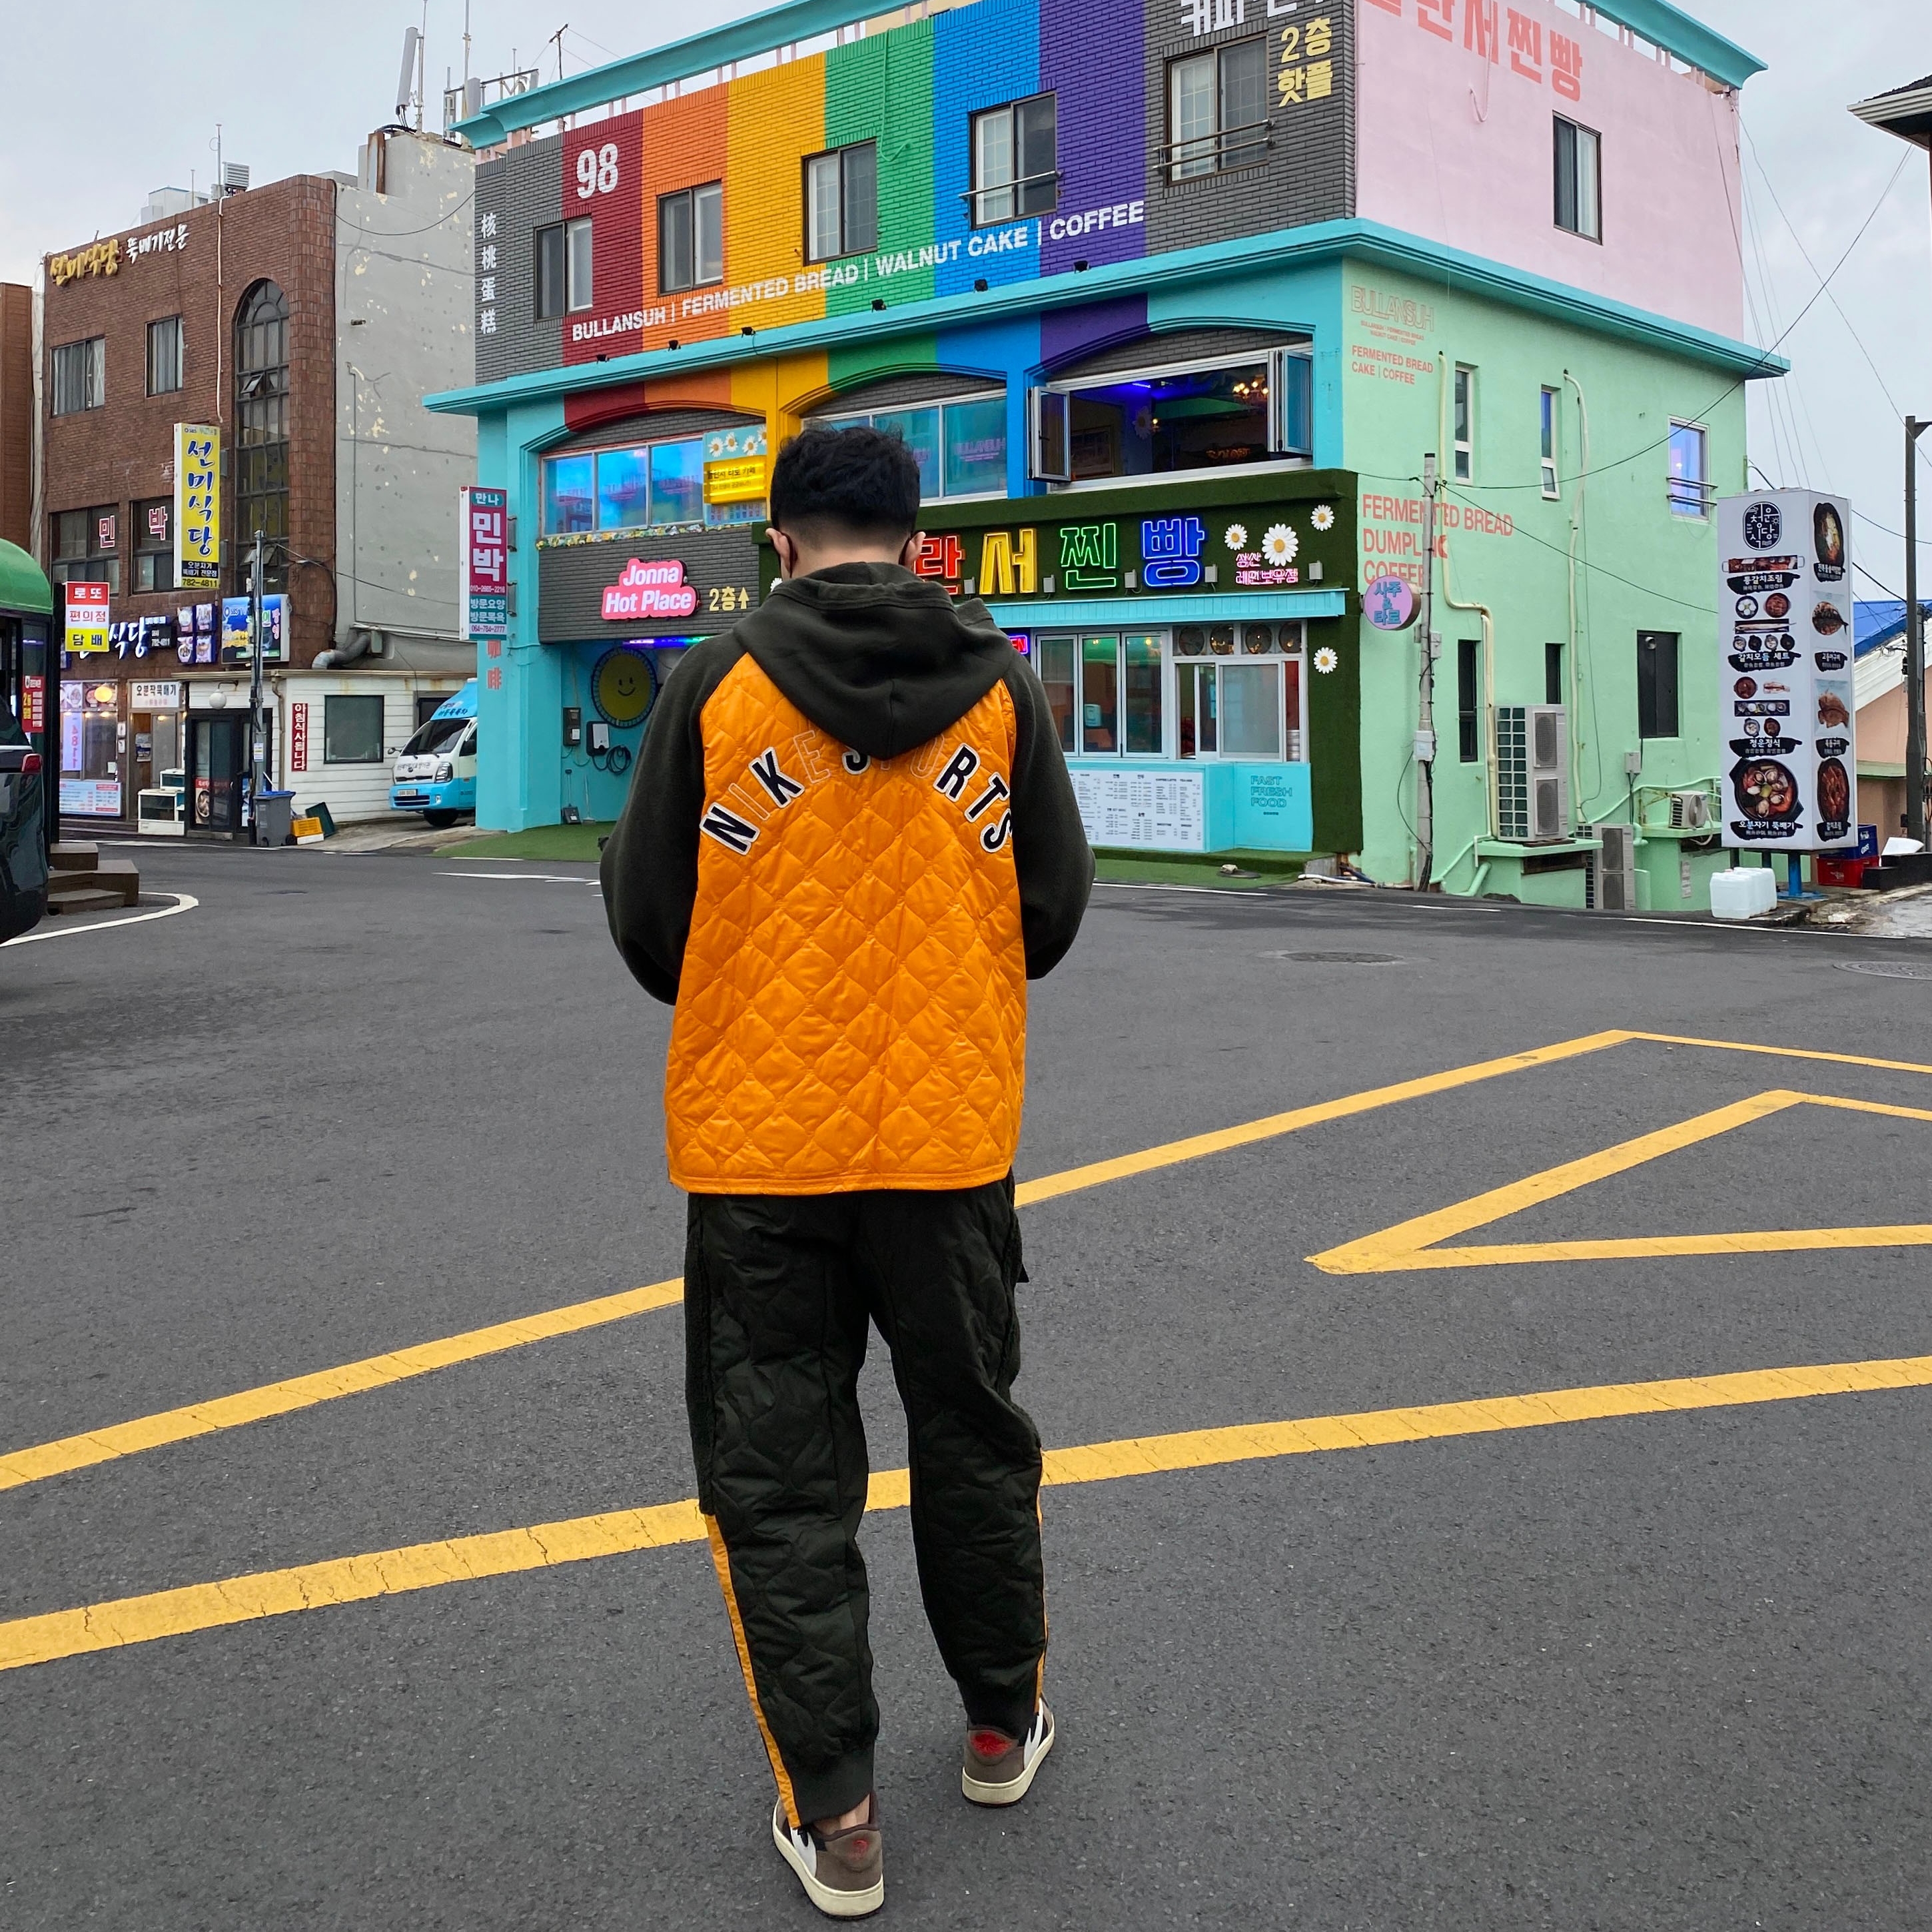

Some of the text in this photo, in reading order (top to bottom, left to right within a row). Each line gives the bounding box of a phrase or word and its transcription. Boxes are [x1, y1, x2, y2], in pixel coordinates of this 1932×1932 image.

[1280, 17, 1332, 63] 2층
[1278, 59, 1332, 107] 핫플
[576, 143, 618, 199] 98
[480, 213, 497, 334] 核桃蛋糕
[572, 200, 1145, 342] BULLANSUH FERMENTED BREAD WALNUT CAKE COFFEE
[1351, 285, 1434, 332] BULLANSUH
[1352, 345, 1433, 373] FERMENTED BREAD
[1352, 361, 1415, 385] CAKE COFFEE
[187, 440, 215, 557] 선미식당
[475, 492, 500, 506] 만나
[1464, 506, 1514, 536] BREAD
[472, 512, 504, 582] 민박
[183, 578, 217, 588] 782-4811
[623, 565, 679, 586] Jonna
[1743, 574, 1783, 586] 통갈치조림
[73, 587, 103, 599] 로또
[709, 586, 735, 612] 2층
[1374, 581, 1402, 598] 사주
[470, 598, 506, 610] 방문요양
[605, 590, 692, 614] Hot Place
[1381, 597, 1393, 611] &
[69, 610, 106, 622] 편의점
[1373, 610, 1402, 626] 타로
[72, 634, 103, 646] 담배
[1773, 652, 1790, 660] 세트
[1250, 775, 1283, 785] FAST
[1250, 786, 1292, 797] FRESH
[1250, 797, 1287, 807] FOOD
